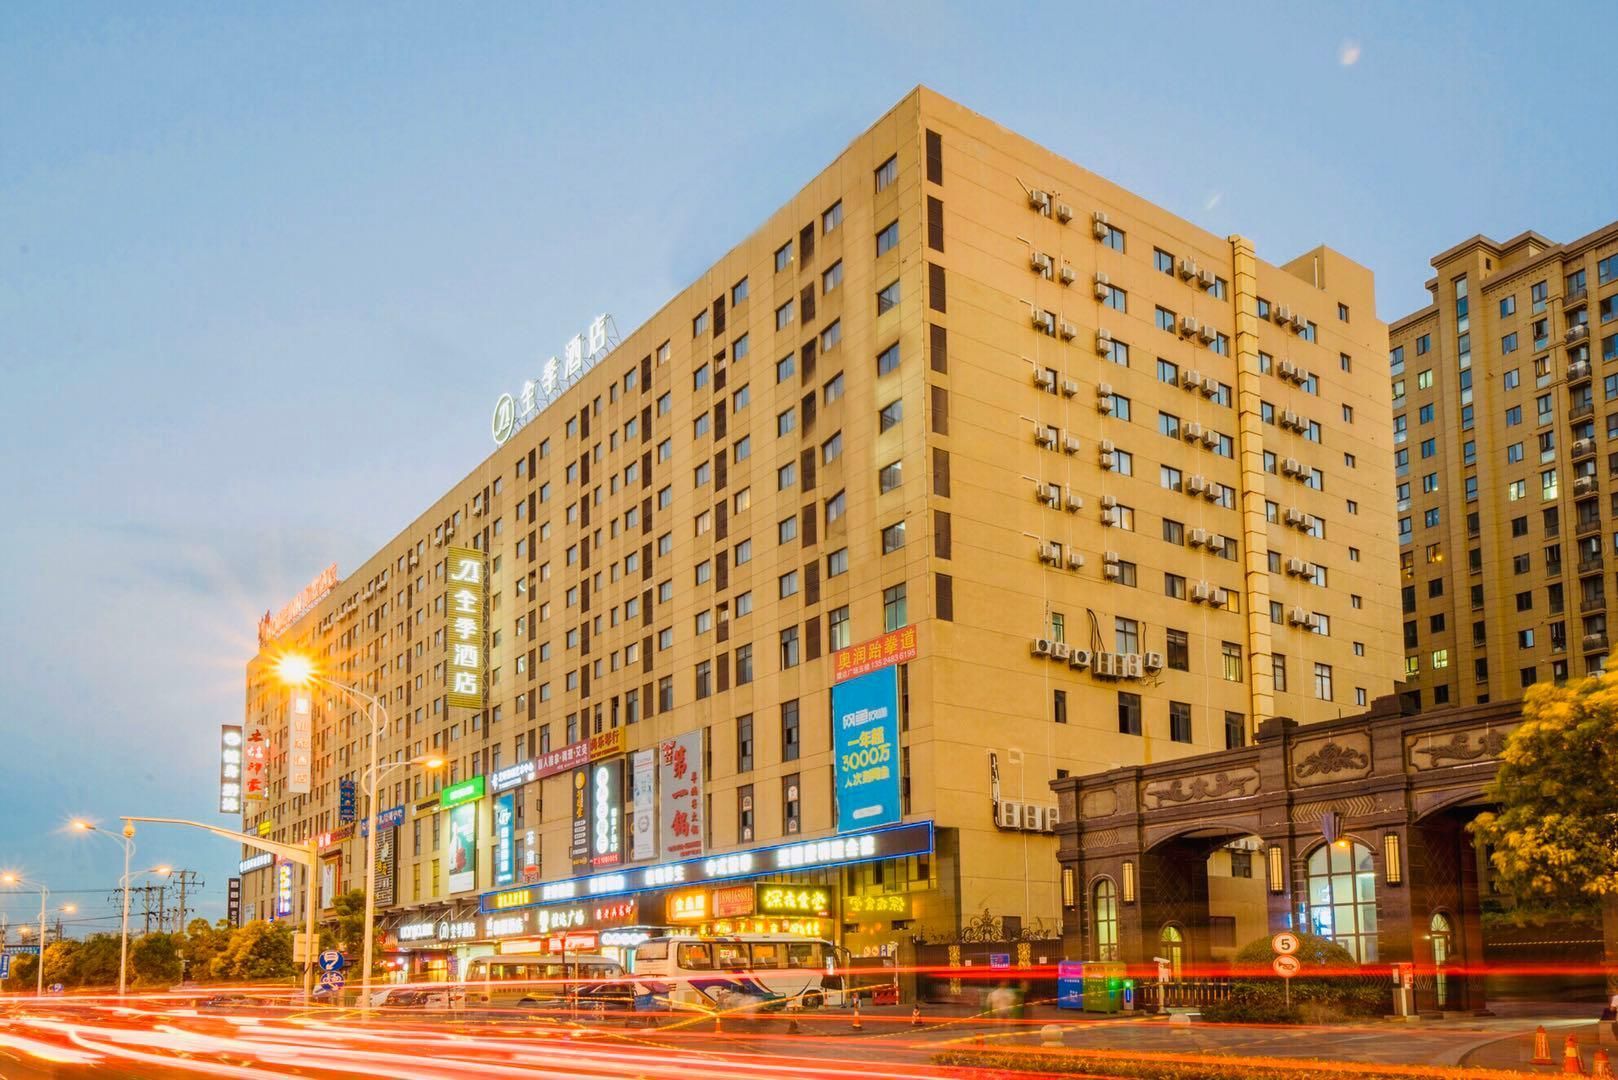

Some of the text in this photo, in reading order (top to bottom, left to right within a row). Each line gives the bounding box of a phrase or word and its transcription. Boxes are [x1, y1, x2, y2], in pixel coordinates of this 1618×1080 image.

[453, 589, 478, 695] 全季酒店
[839, 628, 915, 671] 奥润跆拳道
[764, 889, 827, 911] 深夜食堂
[1281, 938, 1291, 951] 5
